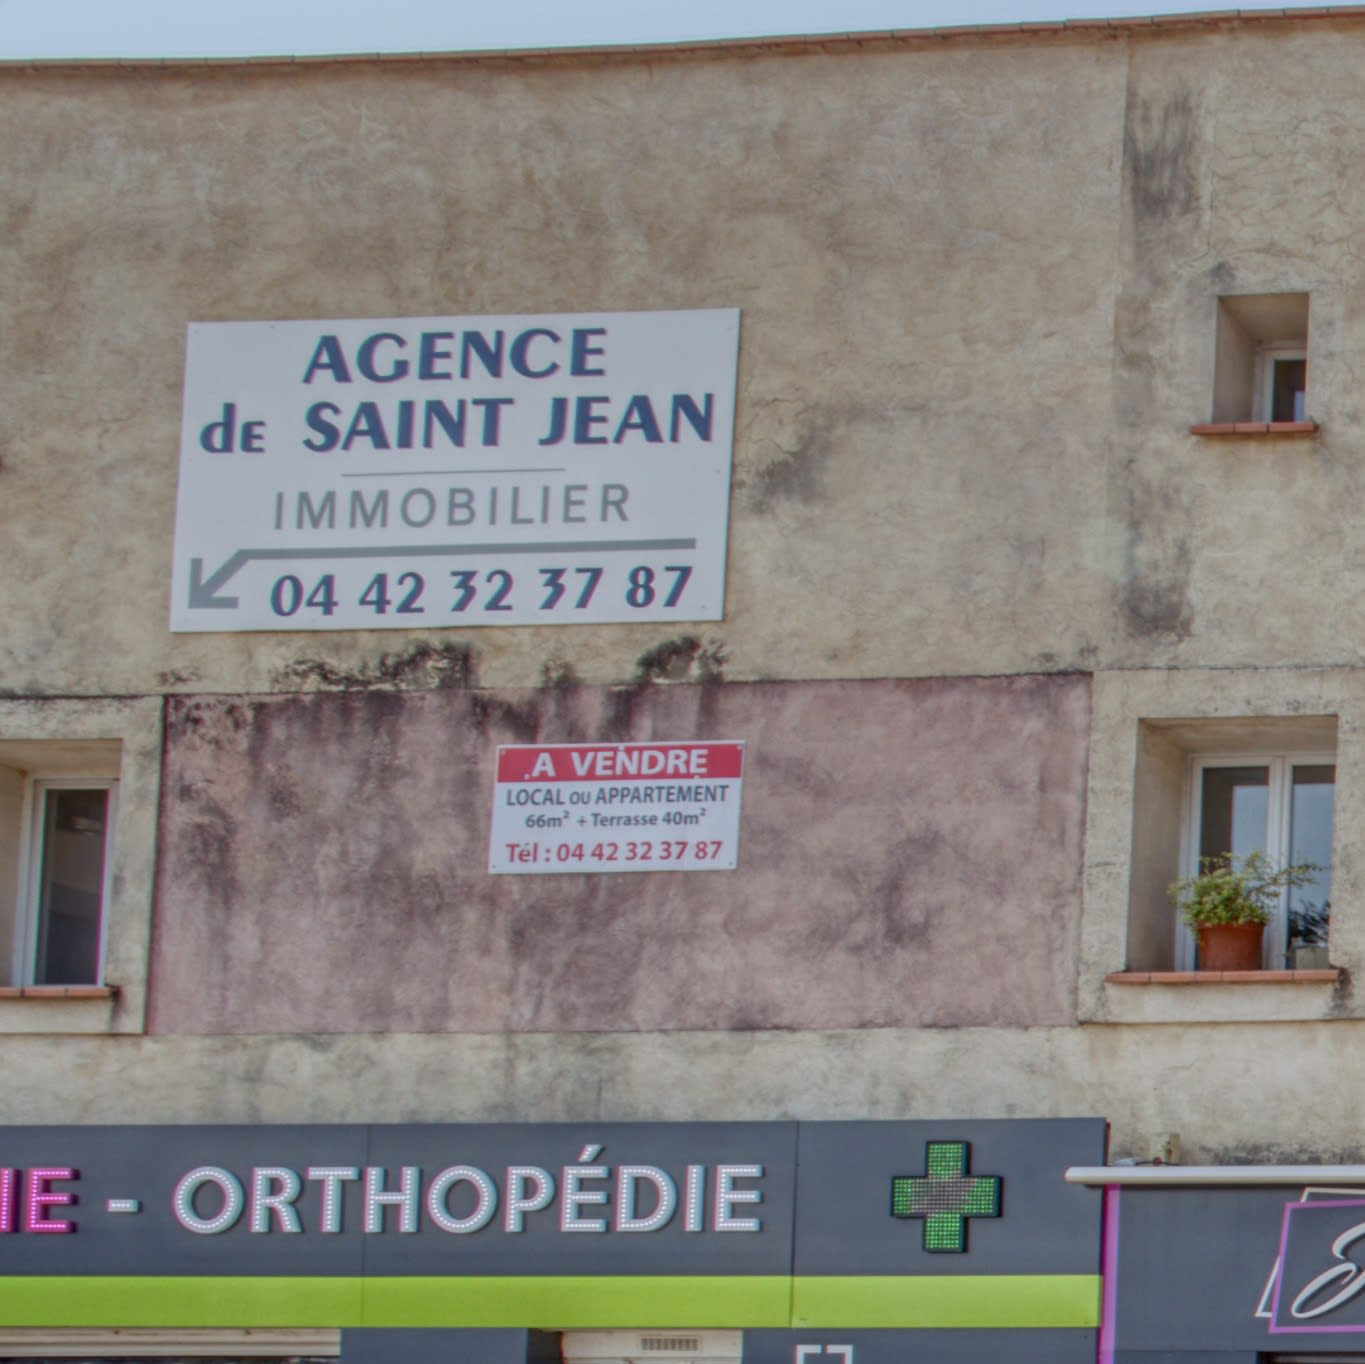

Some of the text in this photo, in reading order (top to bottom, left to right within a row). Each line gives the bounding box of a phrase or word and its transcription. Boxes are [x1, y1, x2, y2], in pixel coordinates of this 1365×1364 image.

[302, 328, 607, 384] AGENCE
[303, 398, 514, 452] SAINT
[538, 393, 715, 447] JEAN
[273, 484, 631, 531] IMMOBILIER
[270, 565, 694, 617] 04 42 32 37 87
[532, 749, 709, 777] A VENDRE
[506, 787, 565, 806] LOCAL
[595, 784, 730, 804] APPARTEMENT
[591, 812, 658, 827] Terrasse
[557, 843, 585, 862] 04
[591, 843, 620, 862] 42
[625, 842, 653, 861] 32
[659, 841, 688, 860] 37
[694, 840, 723, 860] 87
[173, 1144, 764, 1235] ORTHOPÉDIE
